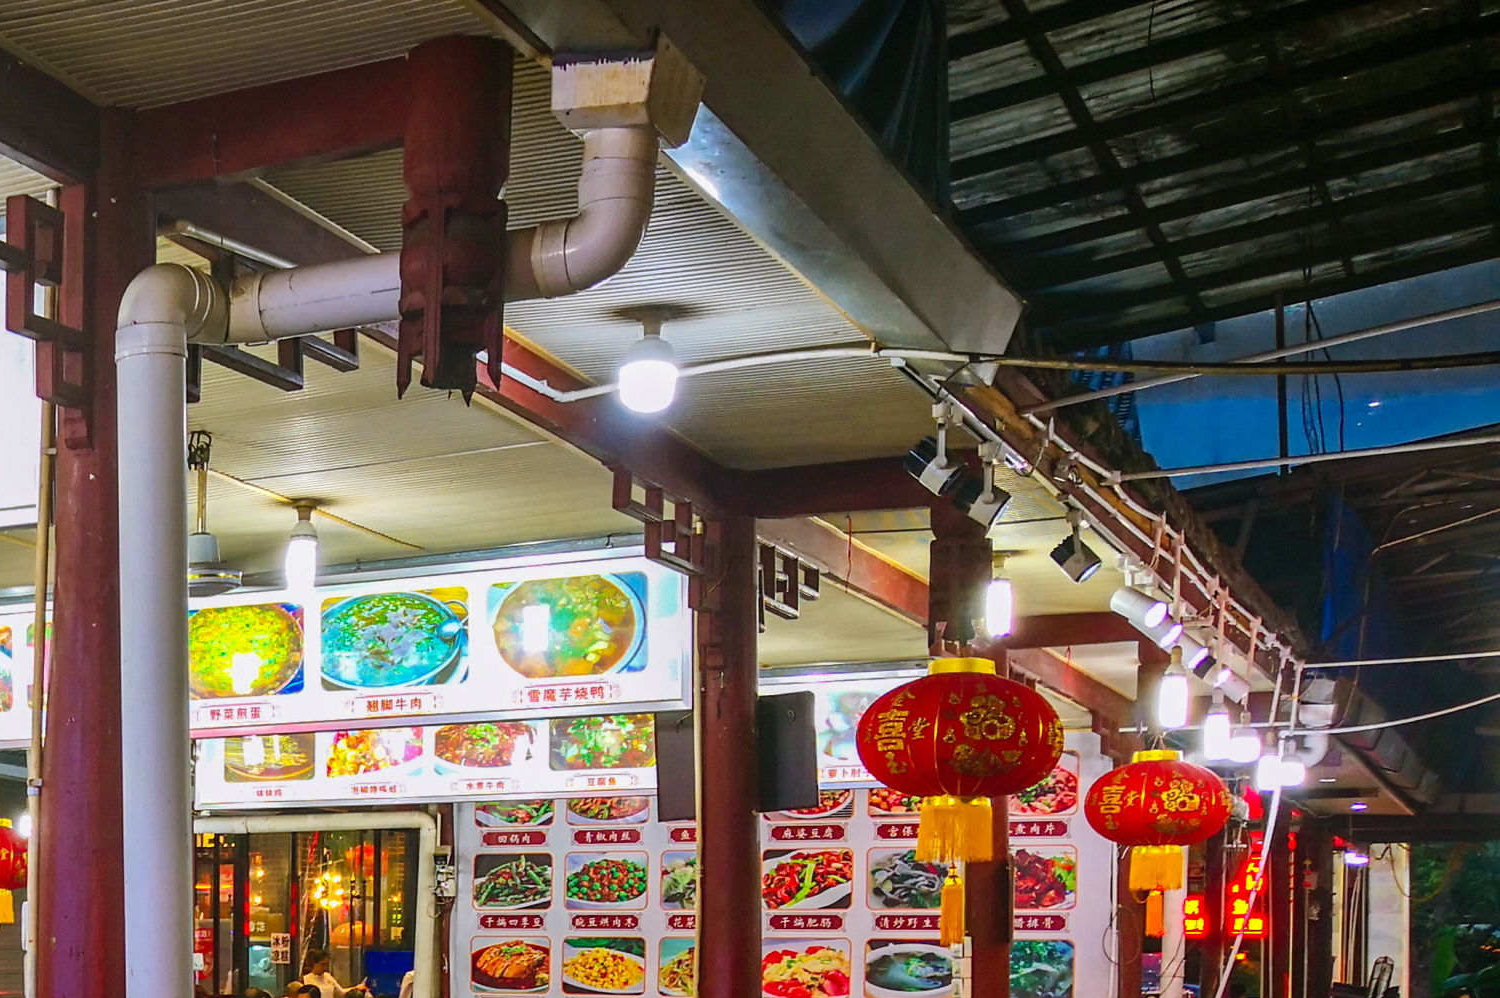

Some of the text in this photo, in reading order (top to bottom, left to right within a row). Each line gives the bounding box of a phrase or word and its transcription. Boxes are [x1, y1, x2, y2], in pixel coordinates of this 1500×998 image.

[527, 686, 605, 703] 雪魔芋烧鸭
[365, 696, 422, 712] 翘脚牛肉
[209, 707, 262, 721] 野菜煎蛋
[828, 768, 869, 779] 萝卜肘
[465, 778, 505, 791] 水煮牛肉
[586, 775, 618, 788] 豆腐鱼
[1100, 785, 1126, 814] 喜
[781, 825, 835, 840] 麻婆豆腐
[887, 825, 920, 837] 宫保
[1008, 822, 1055, 835] 煮肉片
[497, 834, 531, 844] 回锅肉
[583, 831, 632, 843] 青椒肉丝
[484, 917, 543, 929] 干煸四季豆
[779, 915, 832, 929] 干煸肥肠
[879, 917, 941, 929] 清炒野生
